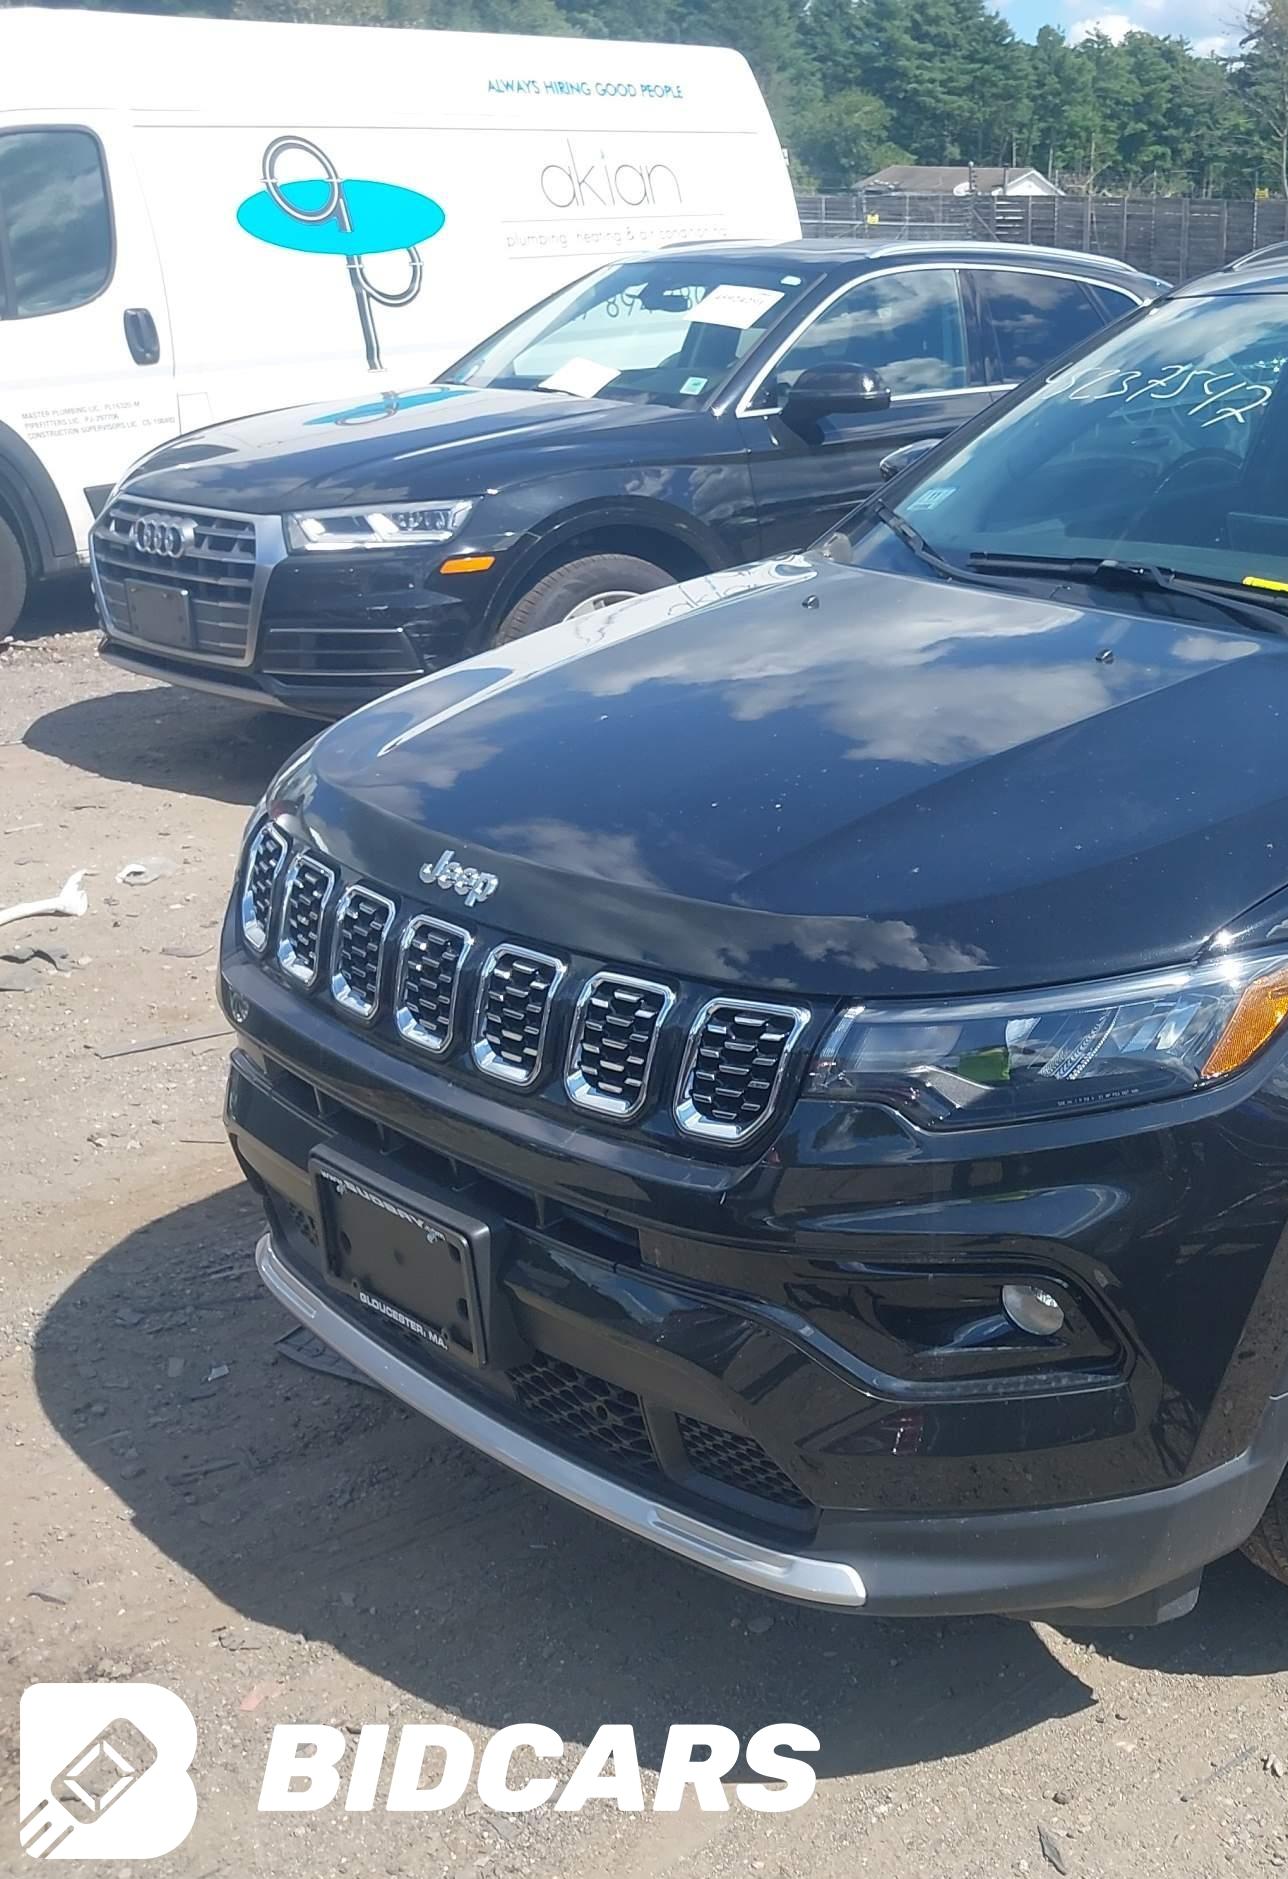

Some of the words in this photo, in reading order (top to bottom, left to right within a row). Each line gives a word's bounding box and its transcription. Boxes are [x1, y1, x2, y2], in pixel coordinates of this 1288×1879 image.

[488, 79, 540, 95] ALWAYS
[544, 81, 591, 96] HIRING
[595, 82, 637, 97] GOOD
[640, 84, 684, 99] PEOPLE
[541, 137, 682, 208] akian
[506, 230, 568, 248] plumbing
[419, 849, 499, 908] Jeep
